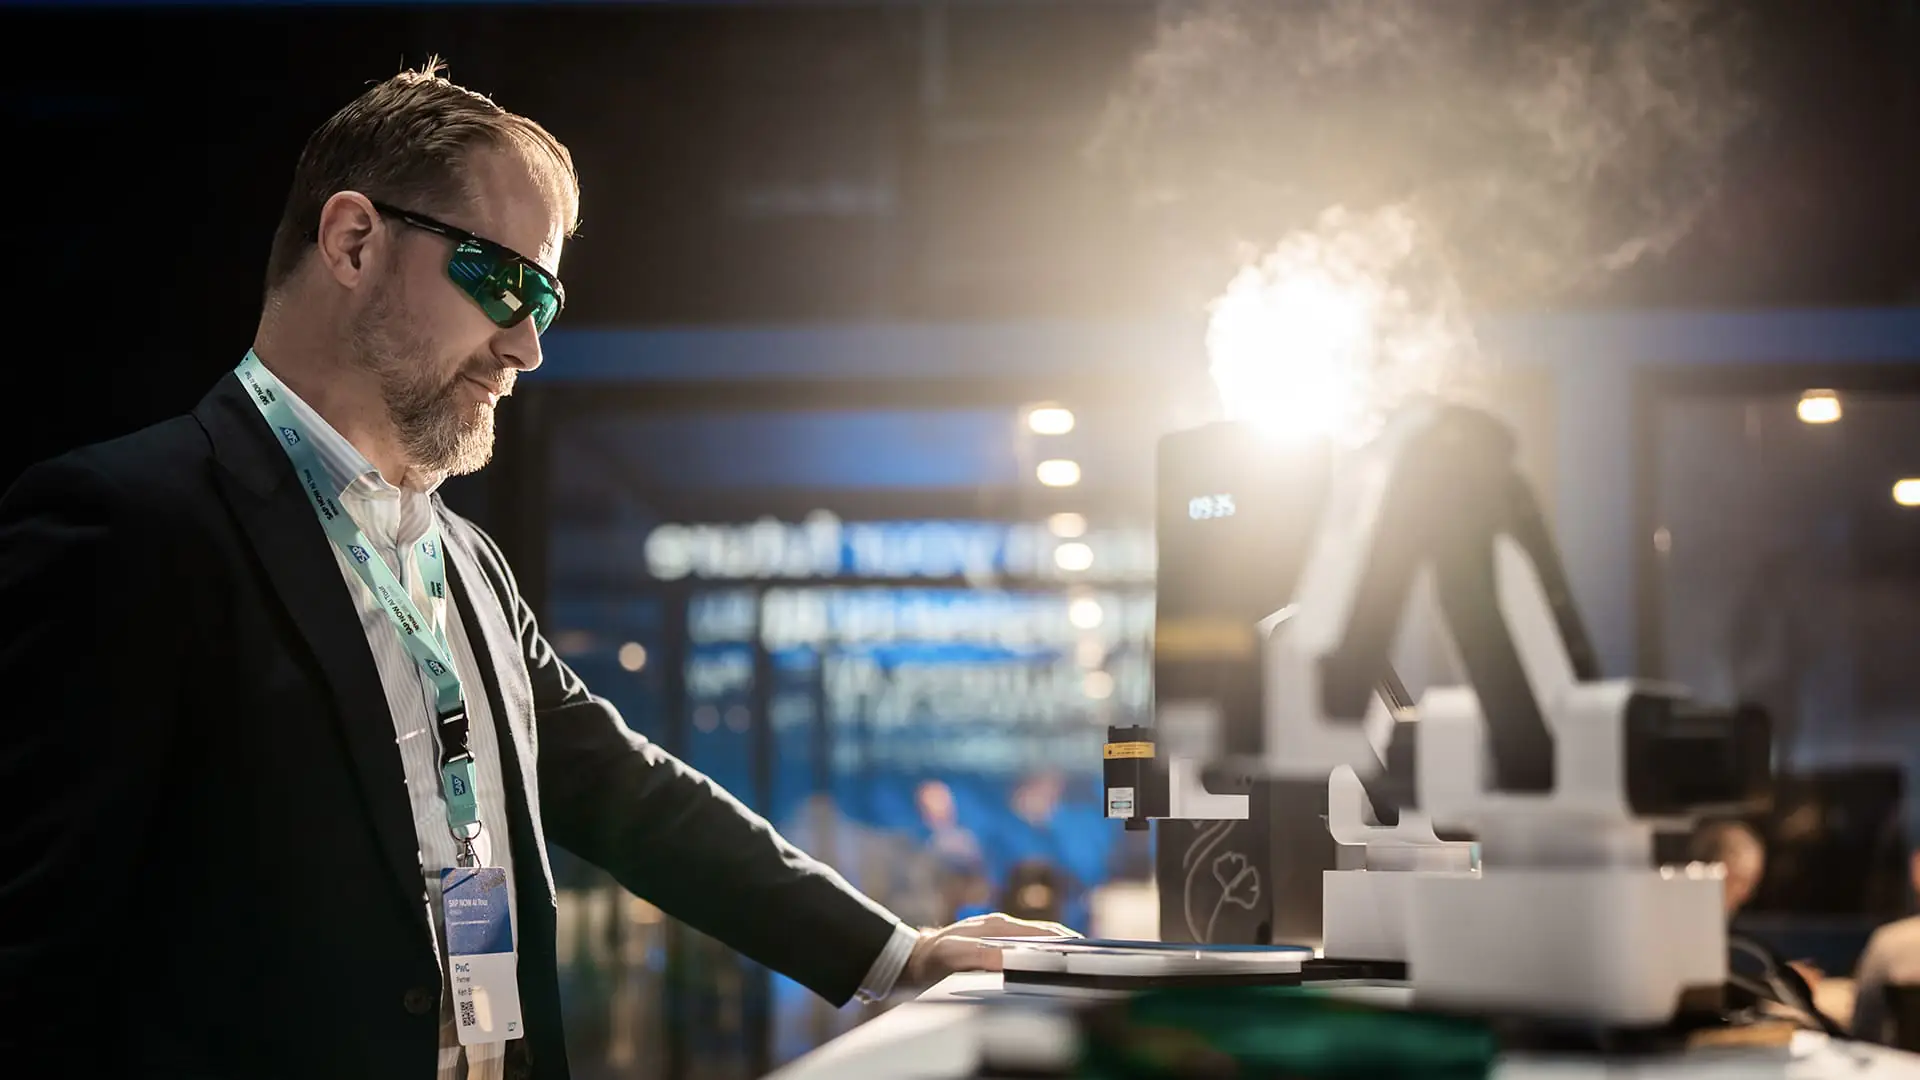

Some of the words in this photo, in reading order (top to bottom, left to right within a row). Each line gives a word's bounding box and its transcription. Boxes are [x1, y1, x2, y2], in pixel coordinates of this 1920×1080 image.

[283, 428, 299, 445] SAP
[351, 546, 368, 562] SAP
[378, 585, 390, 600] Tour
[392, 606, 406, 622] NOW
[403, 622, 414, 635] SAP
[429, 660, 444, 675] SAP
[453, 777, 465, 795] SAP
[455, 962, 470, 973] PwC
